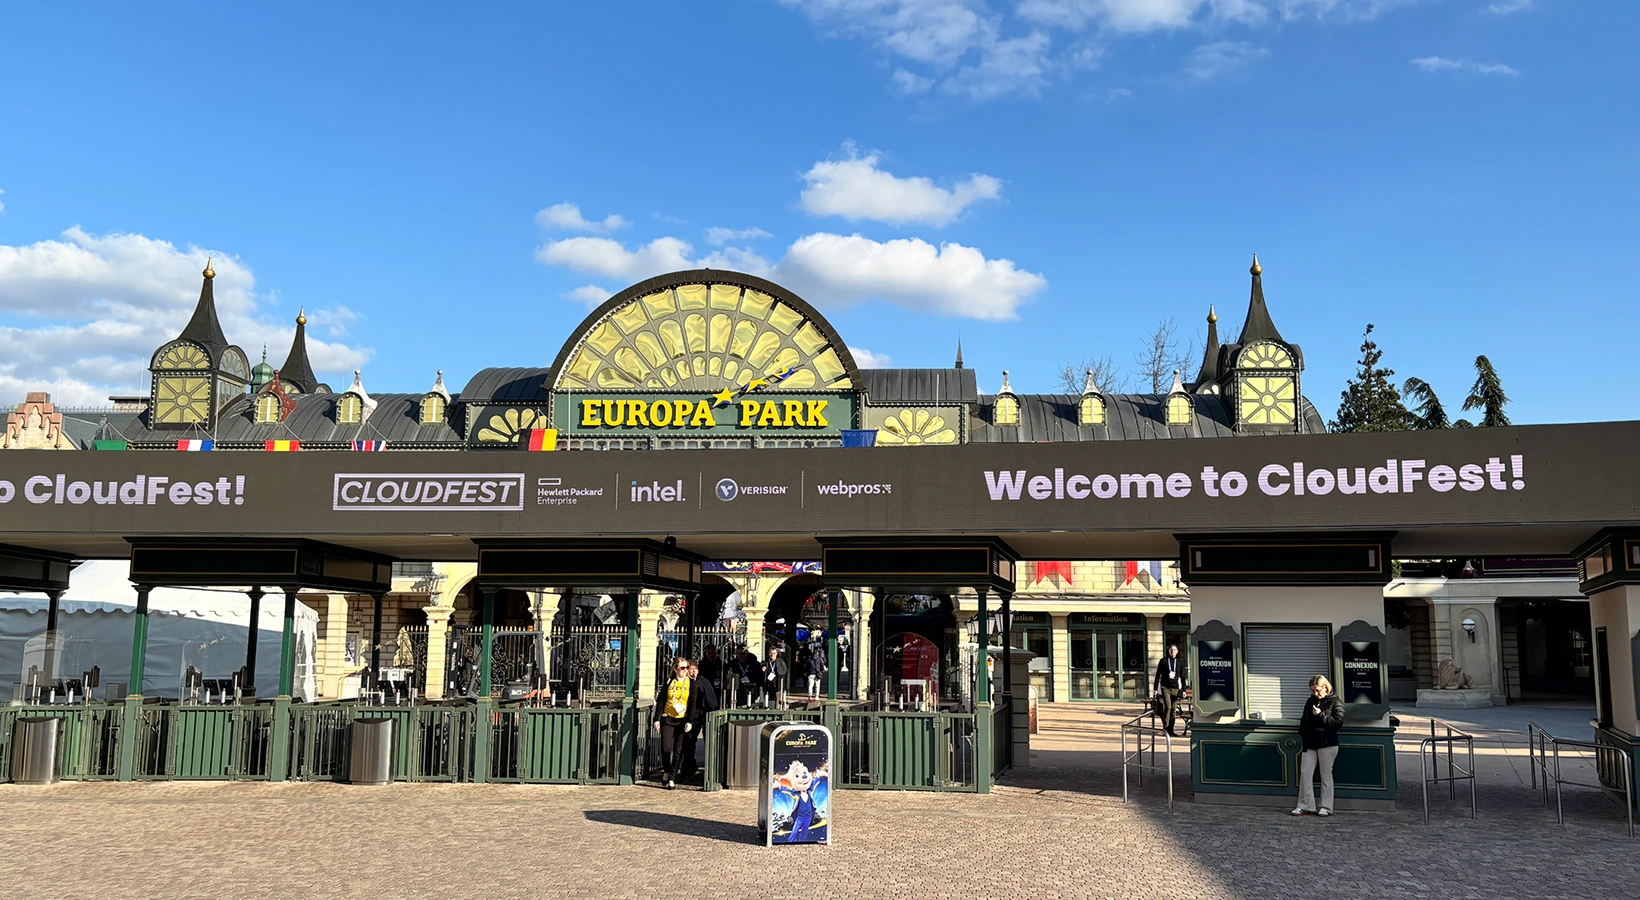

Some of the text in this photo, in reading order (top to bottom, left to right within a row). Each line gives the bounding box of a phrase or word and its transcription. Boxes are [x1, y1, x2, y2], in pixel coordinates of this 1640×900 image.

[582, 399, 828, 427] EUROPA PARK
[984, 454, 1527, 501] Welcome to CloudFest!
[0, 473, 246, 506] o CloudFest!
[340, 480, 517, 503] CLOUDFEST
[537, 488, 603, 497] Hewlett Packard
[817, 480, 880, 498] webpros
[537, 496, 578, 506] Enterprise
[1083, 614, 1128, 623] Information
[1199, 660, 1232, 668] CONNEXION
[1344, 661, 1379, 669] CONNEXION
